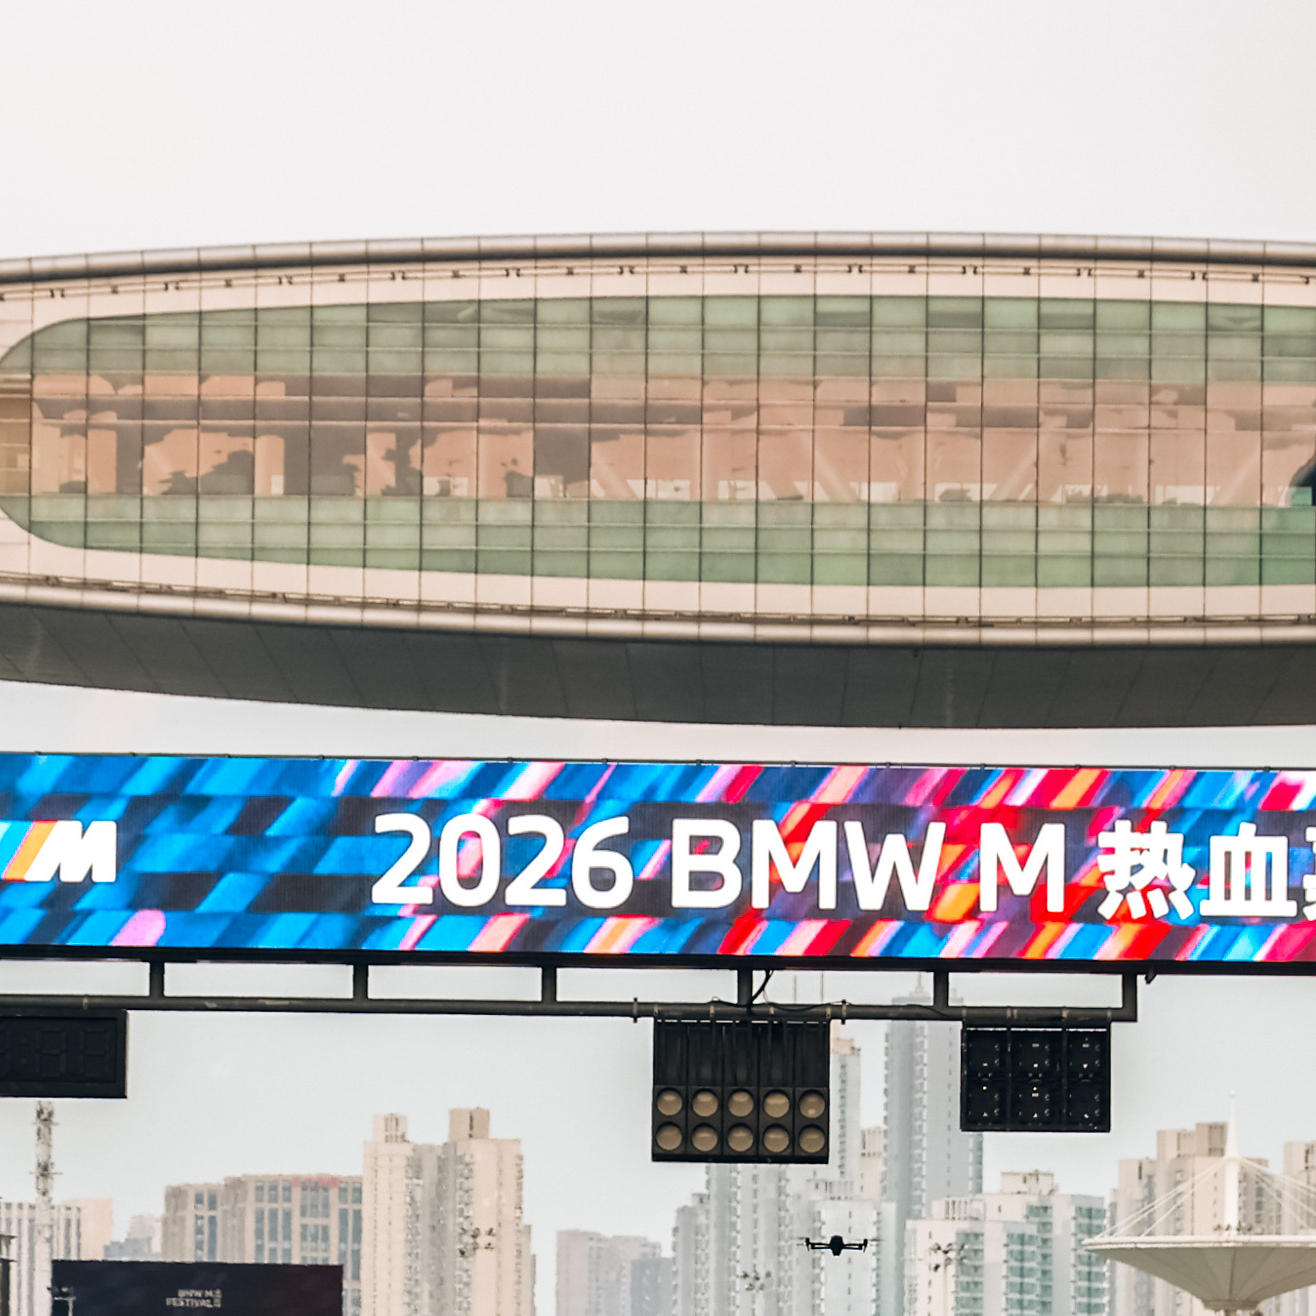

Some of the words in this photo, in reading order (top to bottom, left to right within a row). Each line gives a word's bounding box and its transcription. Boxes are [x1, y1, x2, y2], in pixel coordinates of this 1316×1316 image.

[24, 819, 118, 882] M
[371, 813, 636, 908] 2026
[671, 817, 947, 911] BMW
[978, 821, 1066, 913] M
